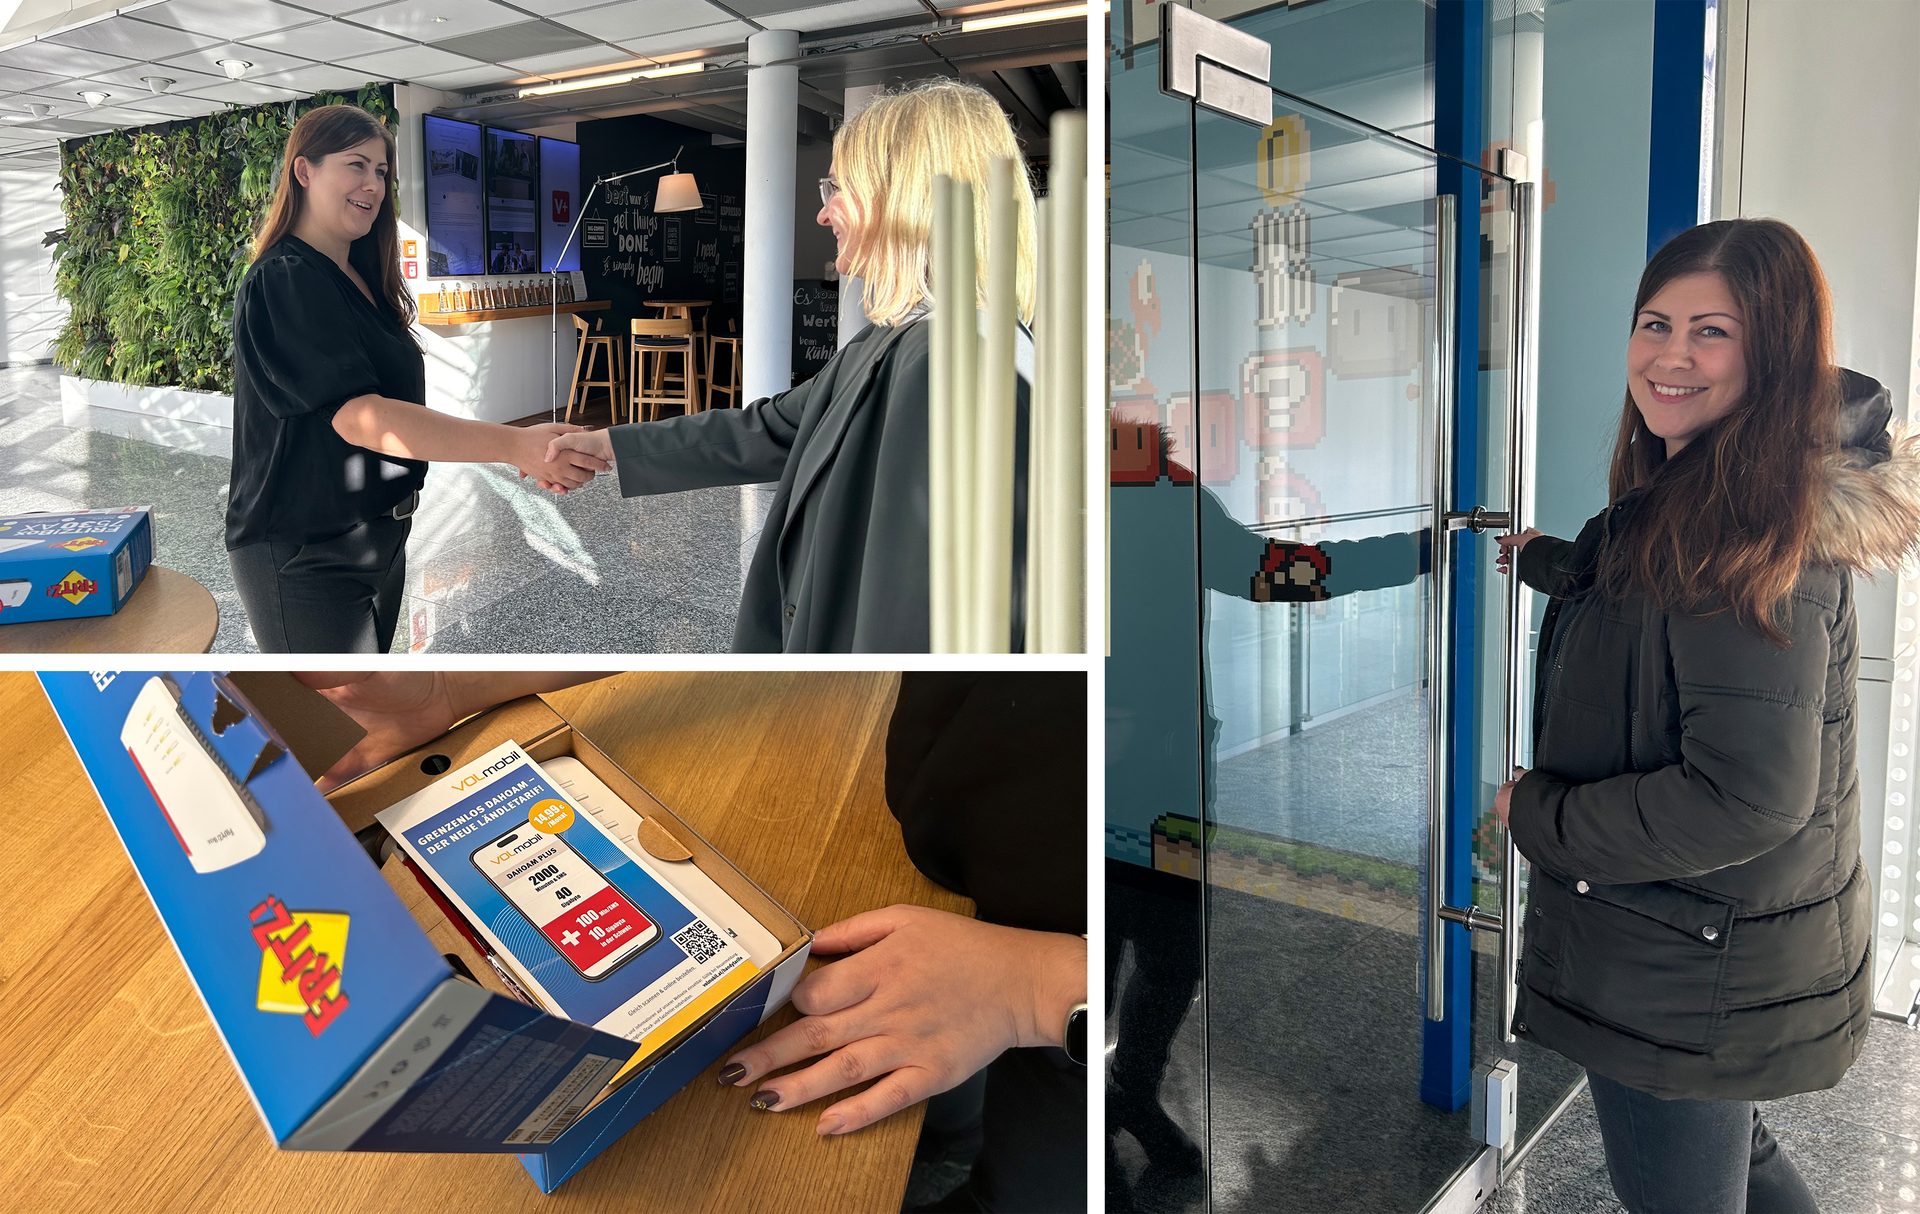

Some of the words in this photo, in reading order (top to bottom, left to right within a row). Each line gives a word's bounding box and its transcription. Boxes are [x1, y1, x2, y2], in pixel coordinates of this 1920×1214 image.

[605, 184, 629, 205] best
[629, 195, 642, 205] WAY
[554, 199, 568, 214] V+
[613, 208, 629, 236] get
[633, 209, 658, 237] things
[618, 235, 649, 253] DONE
[613, 256, 635, 278] simply
[636, 257, 664, 293] begin
[794, 288, 813, 305] Es
[803, 314, 838, 327] Wert
[25, 522, 60, 531] AX
[60, 520, 124, 529] 7530
[46, 579, 99, 598] FRITZ!
[451, 751, 521, 791] VOLmobil
[417, 805, 485, 846] GRENZENLOS
[485, 781, 528, 809] DAHOAM
[426, 841, 450, 855] DER
[449, 823, 478, 842] NEUE
[477, 785, 545, 827] LÄNDLETARIF!
[534, 804, 560, 825] 14,99
[547, 812, 568, 828] /Monat
[490, 833, 543, 867] VOLmobil
[506, 858, 538, 880] DAHOAM
[538, 847, 557, 862] PLUS
[528, 864, 559, 886] 2000
[535, 878, 554, 892] Minuten
[558, 872, 567, 880] SMS
[555, 886, 572, 901] 40
[560, 894, 582, 908] Gigabyte
[575, 909, 600, 928] 100
[599, 901, 619, 916] Min/SMS
[588, 926, 606, 941] 10
[605, 918, 626, 933] Gigabyte
[606, 935, 615, 944] der
[613, 924, 632, 939] Schweiz
[249, 893, 350, 1039] FRITZ!
[628, 1003, 643, 1017] Gleich
[642, 991, 661, 1009] scannen
[663, 979, 679, 992] online
